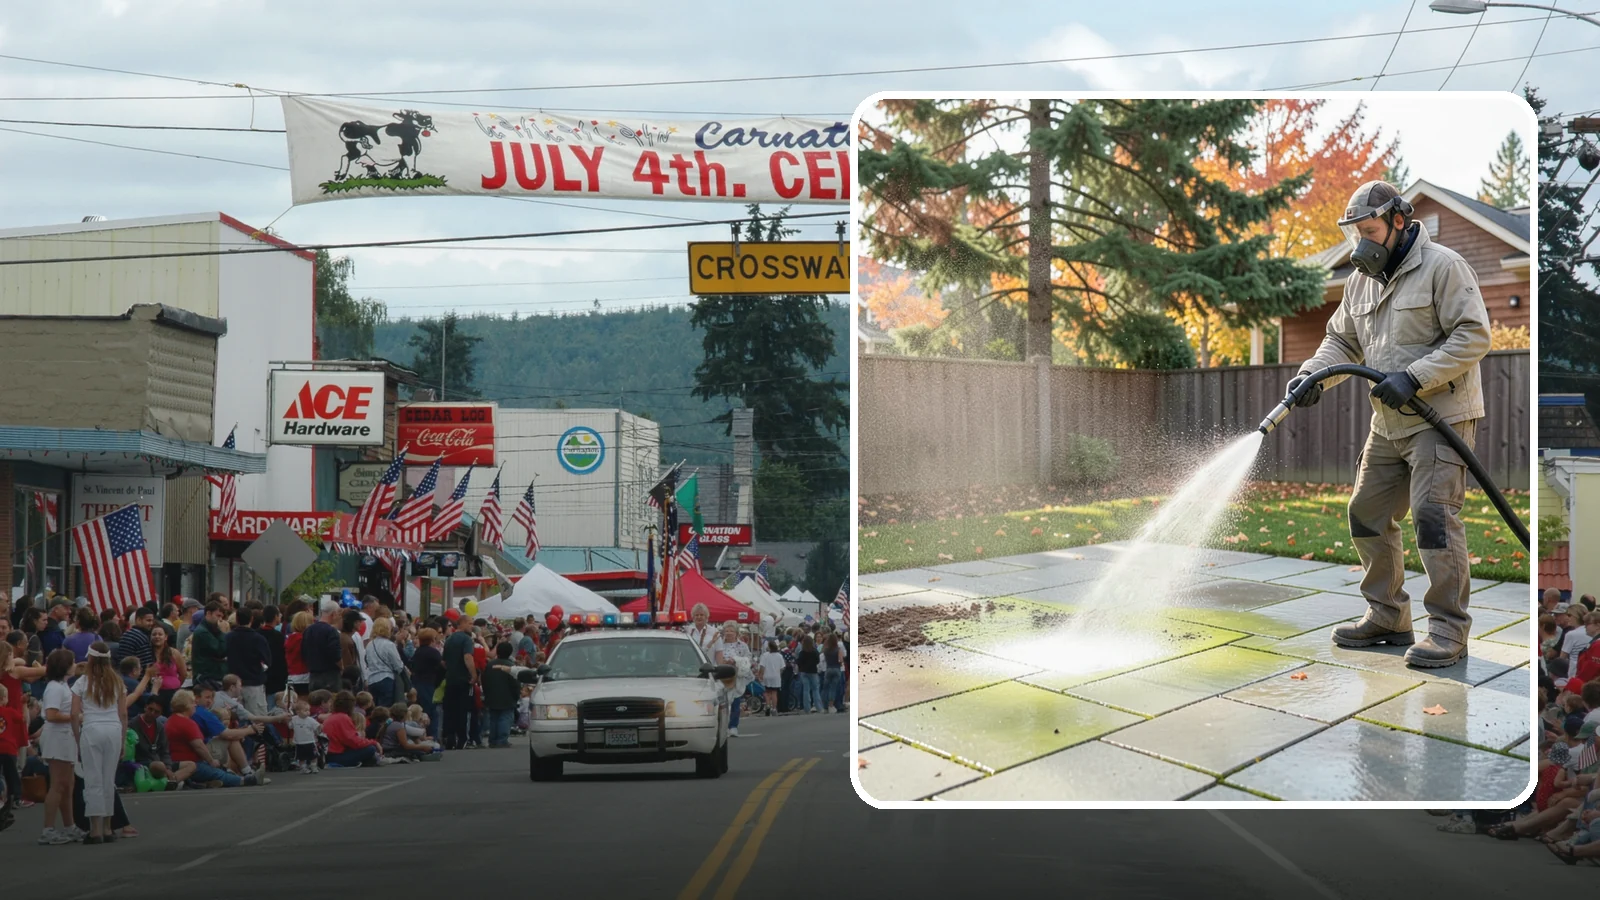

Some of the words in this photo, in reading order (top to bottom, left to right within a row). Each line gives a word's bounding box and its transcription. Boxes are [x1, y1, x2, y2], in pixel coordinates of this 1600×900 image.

[481, 141, 605, 193] JULY
[632, 149, 747, 197] 4th.
[697, 254, 850, 280] CROSSWA
[282, 380, 373, 420] ACE
[406, 409, 452, 421] CEDAR
[460, 409, 486, 421] LOG
[283, 420, 371, 437] Hardware
[416, 428, 477, 447] Coca-Cola
[83, 485, 94, 494] St.
[95, 484, 124, 494] Vincent
[126, 485, 136, 494] de
[137, 485, 155, 495] Paul
[688, 526, 742, 535] CRNATION
[699, 535, 730, 543] GLASS
